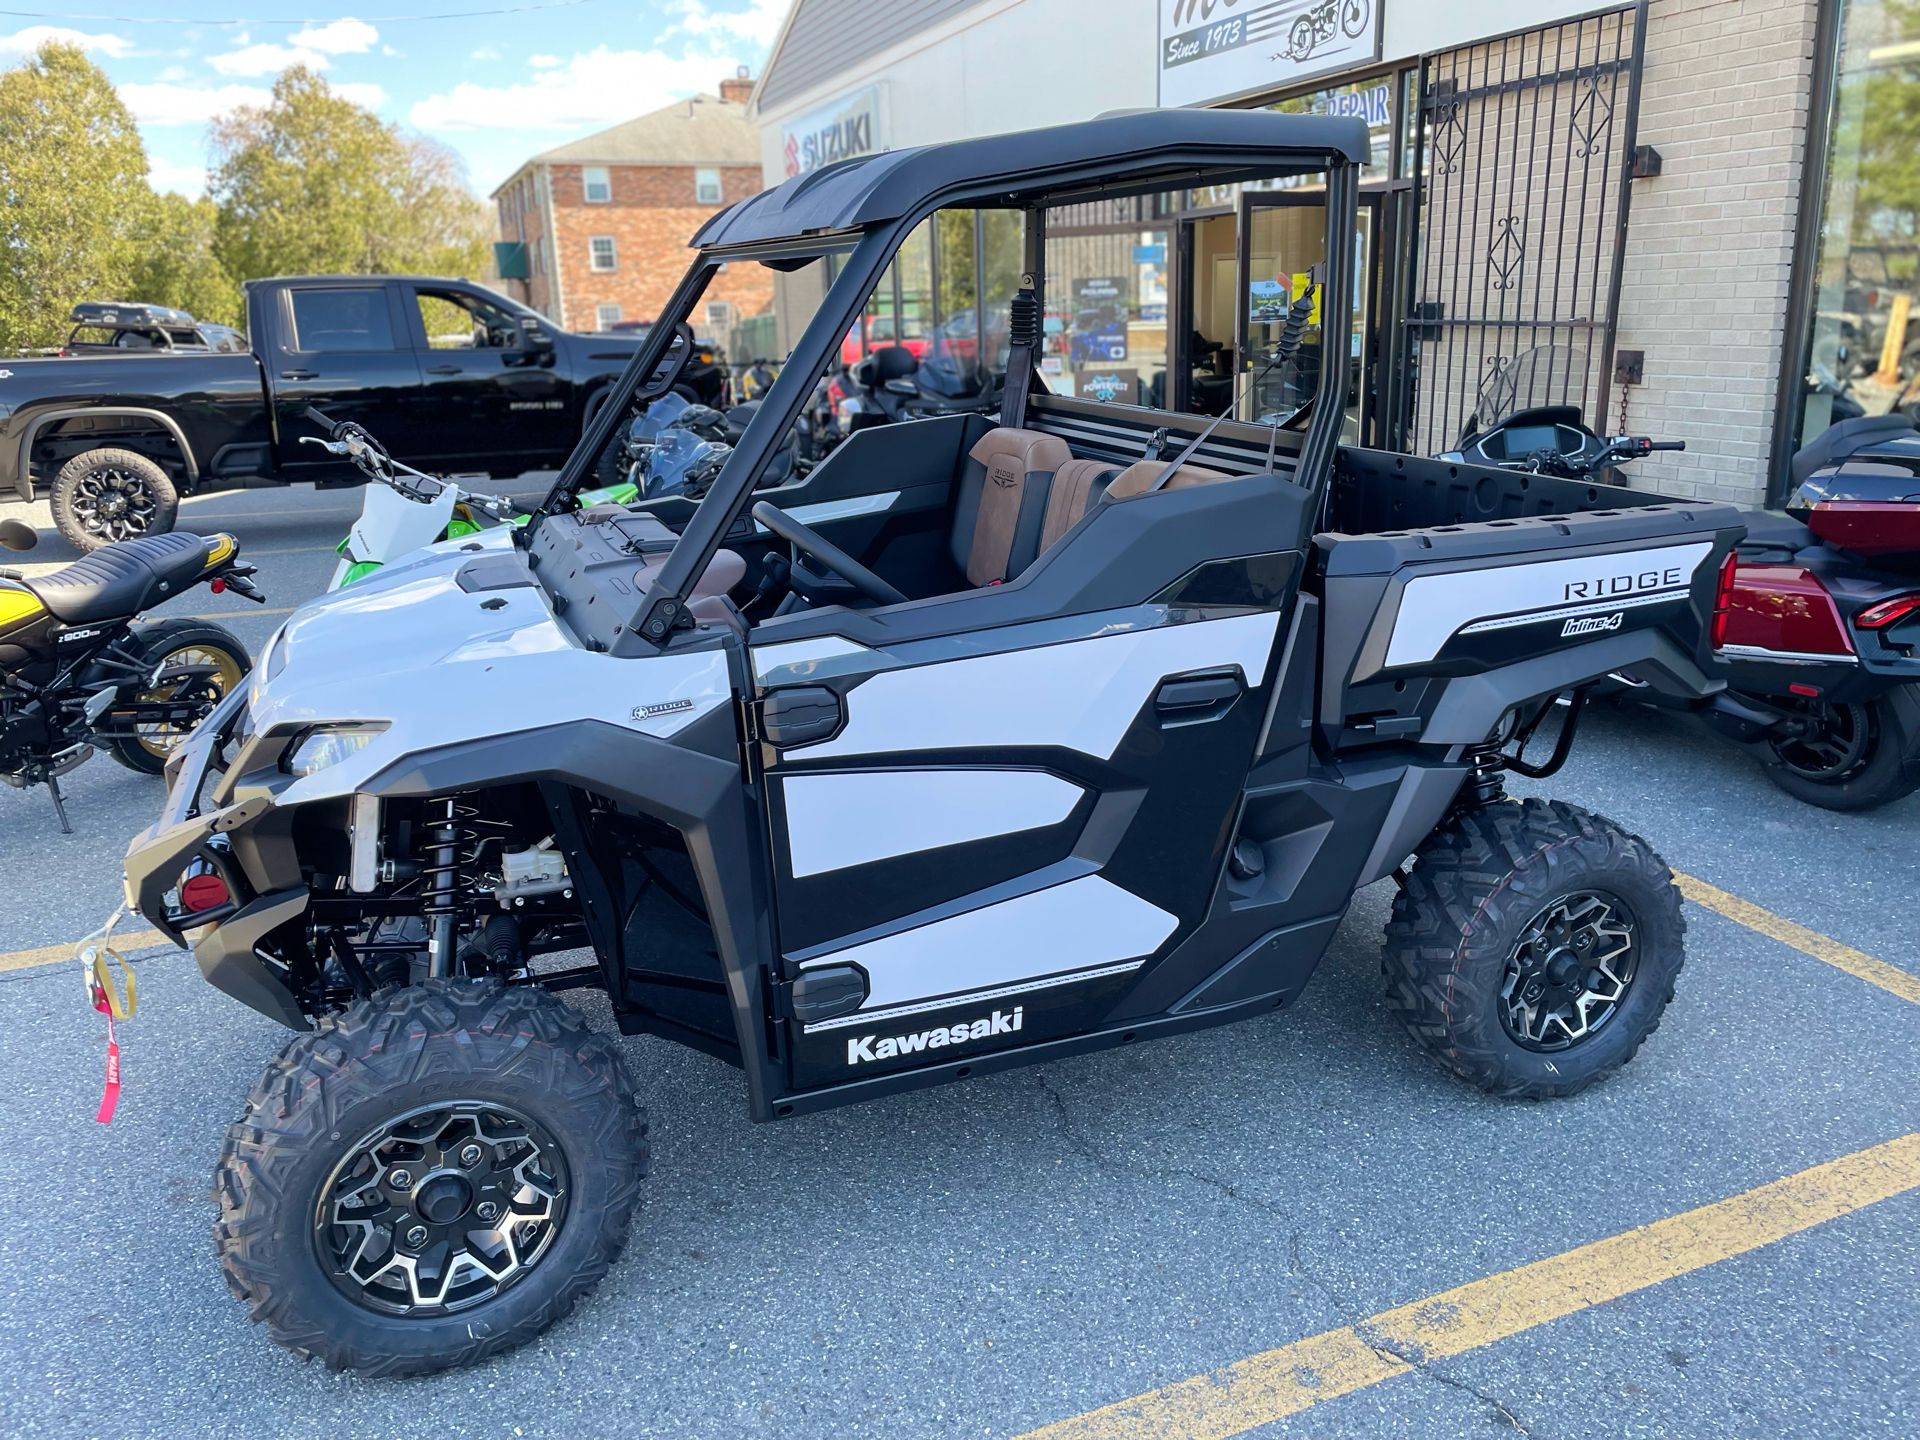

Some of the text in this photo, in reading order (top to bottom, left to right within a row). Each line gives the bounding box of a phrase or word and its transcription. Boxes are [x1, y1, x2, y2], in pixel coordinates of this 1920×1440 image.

[1166, 19, 1242, 63] Since 1973
[802, 112, 871, 171] SUZUKI
[995, 467, 1016, 480] RIDGE
[1564, 567, 1681, 601] RIDGE
[1561, 612, 1624, 637] Inline-4
[649, 700, 690, 713] RIDGE
[847, 1006, 1023, 1065] Kawasaki
[108, 1055, 119, 1084] WARN
